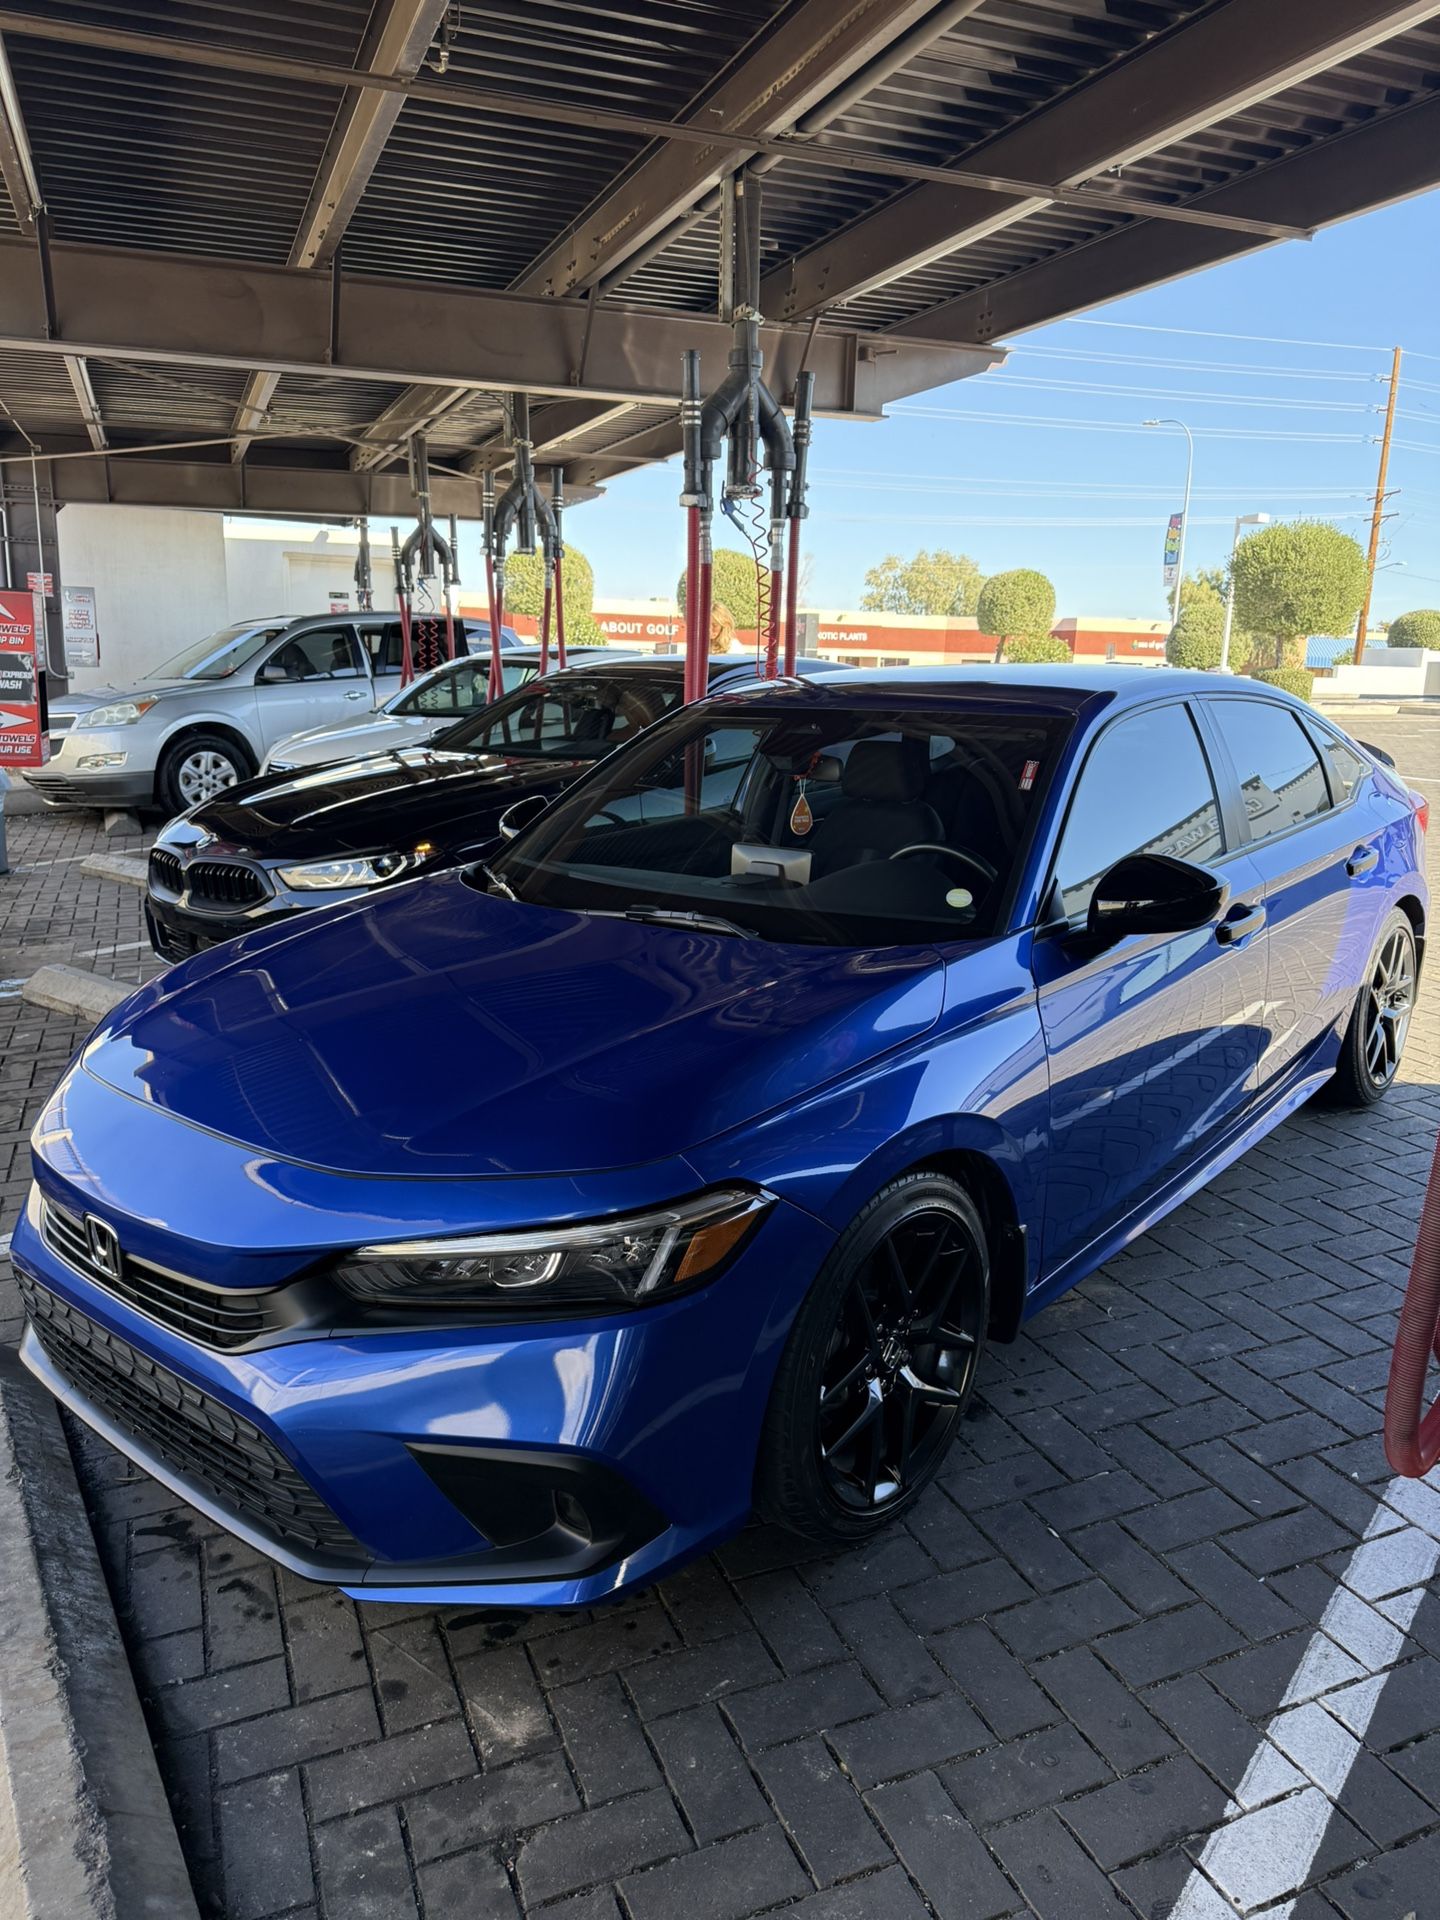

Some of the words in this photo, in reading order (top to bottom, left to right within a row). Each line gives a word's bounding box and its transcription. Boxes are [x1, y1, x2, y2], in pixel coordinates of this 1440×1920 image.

[0, 624, 30, 634] WELS
[600, 620, 643, 634] ABOUT
[646, 623, 679, 635] GOLF
[9, 636, 24, 645] BIN
[839, 632, 867, 641] PLANTS
[2, 670, 32, 679] EXPRESS
[15, 745, 32, 753] USE
